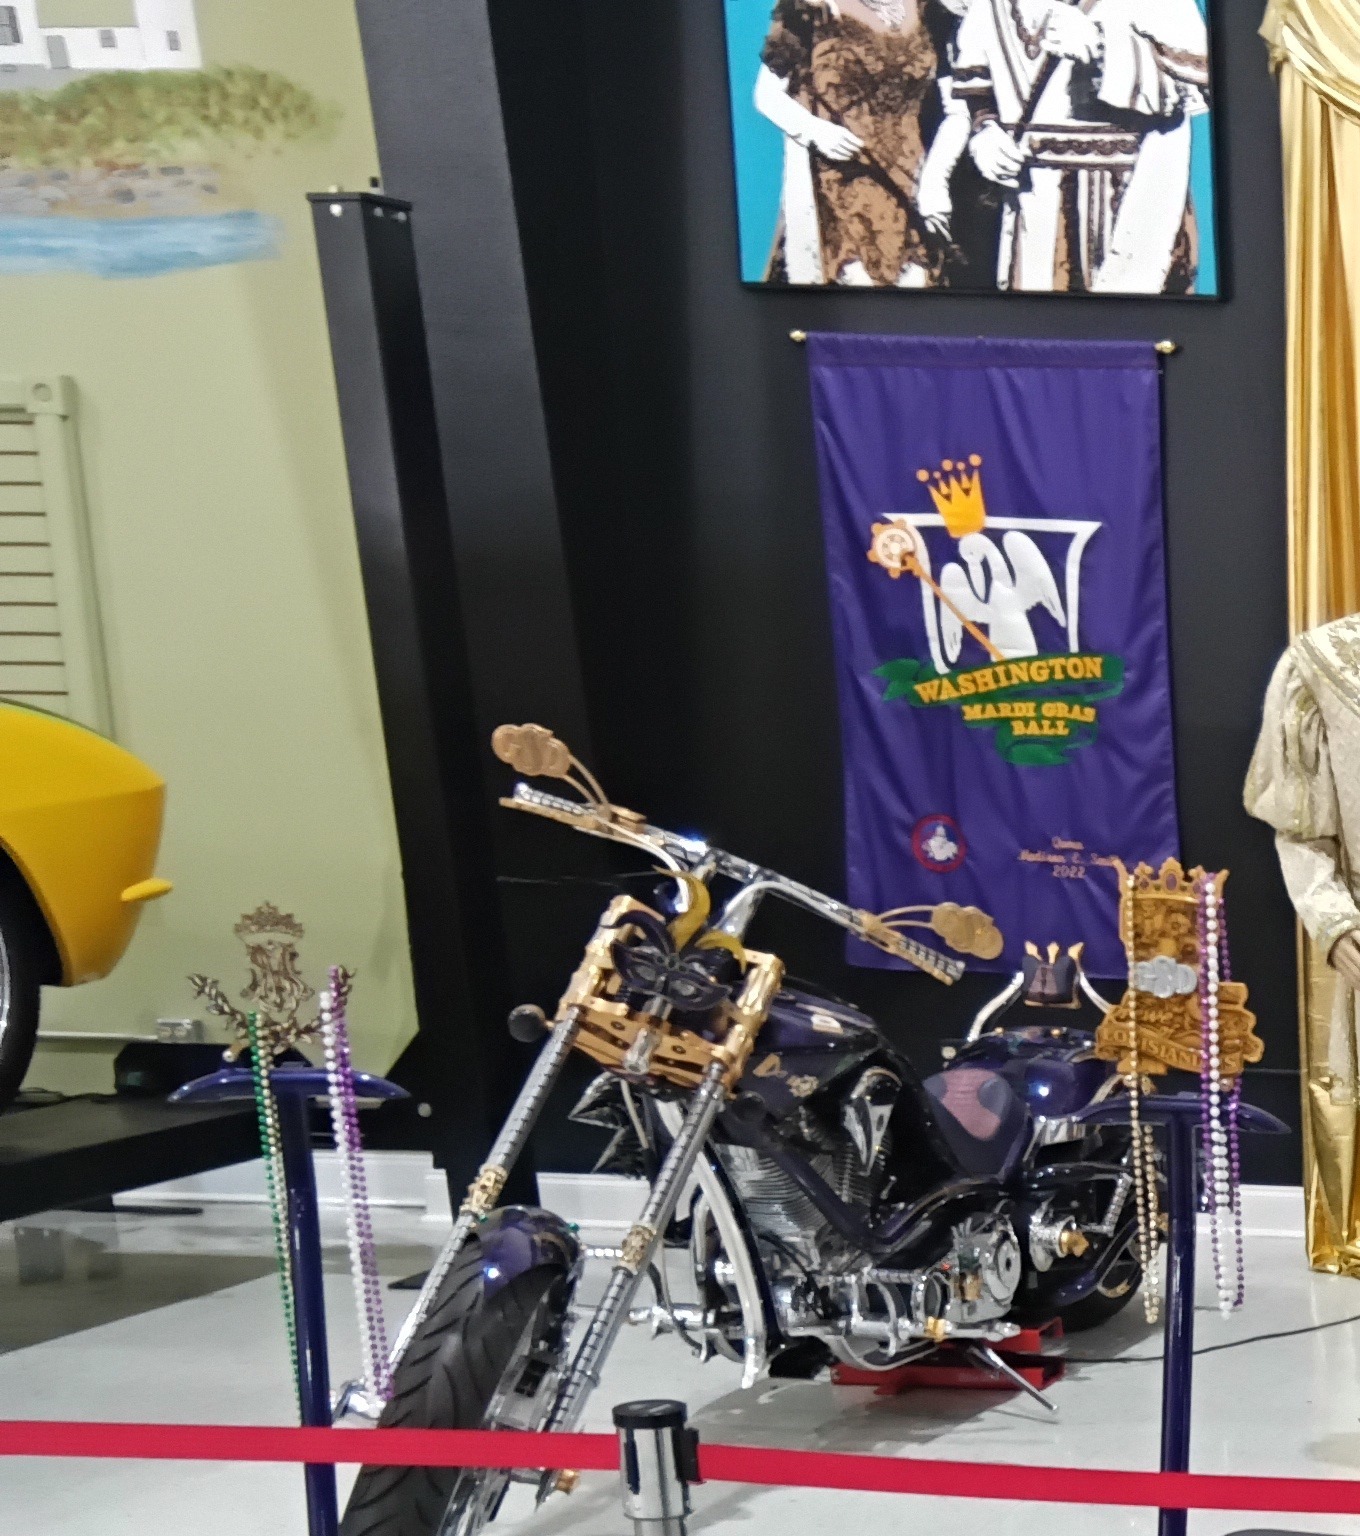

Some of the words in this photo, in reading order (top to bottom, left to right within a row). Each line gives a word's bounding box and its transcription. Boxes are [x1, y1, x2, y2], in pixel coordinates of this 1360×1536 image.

[914, 657, 1103, 704] WASHINGTON
[963, 702, 1036, 720] MARDI
[1041, 702, 1096, 722] GRAS
[1012, 720, 1069, 735] BALL
[1052, 865, 1086, 879] 2022
